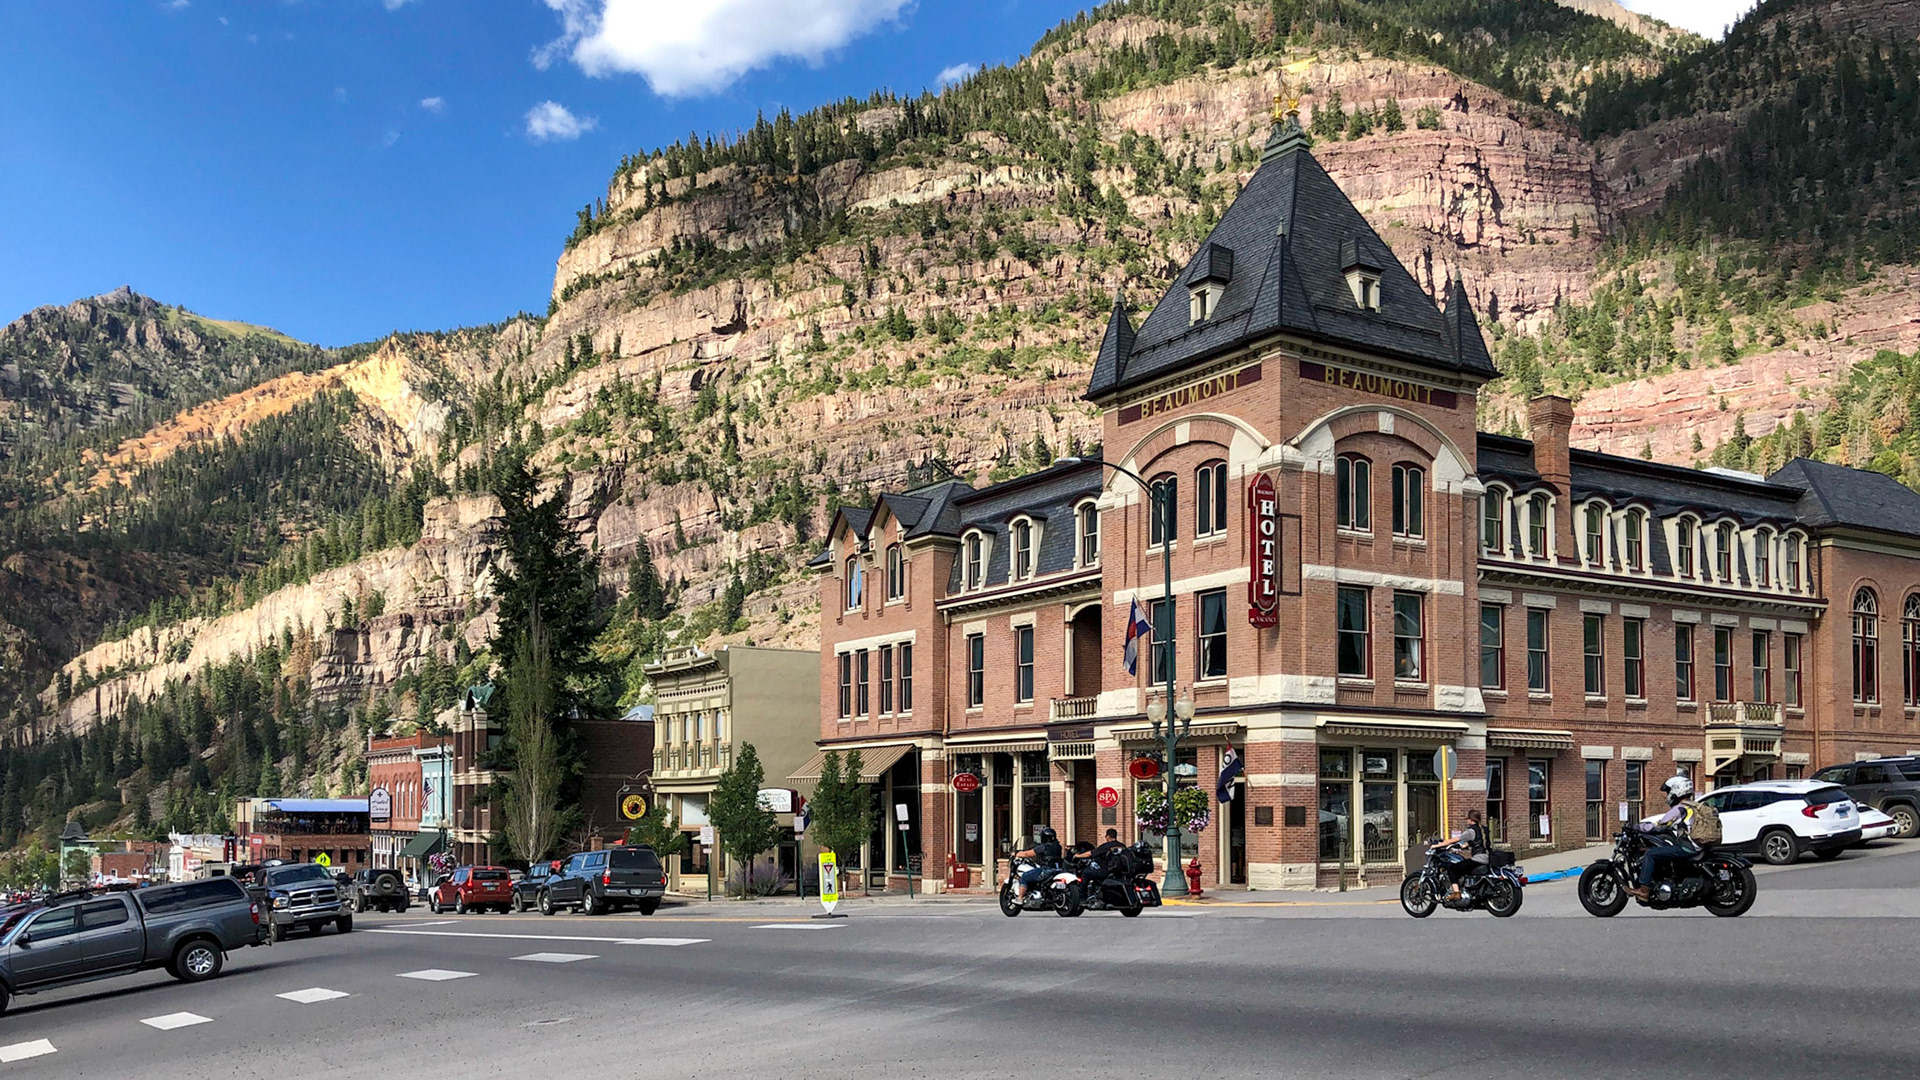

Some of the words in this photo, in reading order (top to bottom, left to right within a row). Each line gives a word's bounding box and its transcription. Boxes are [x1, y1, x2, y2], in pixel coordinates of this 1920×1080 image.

[1141, 370, 1240, 419] BEAUMONT
[1325, 365, 1434, 404] BEAUMONT
[1260, 499, 1275, 595] HOTEL
[1061, 730, 1080, 739] HOTEL
[1099, 793, 1116, 801] SPA
